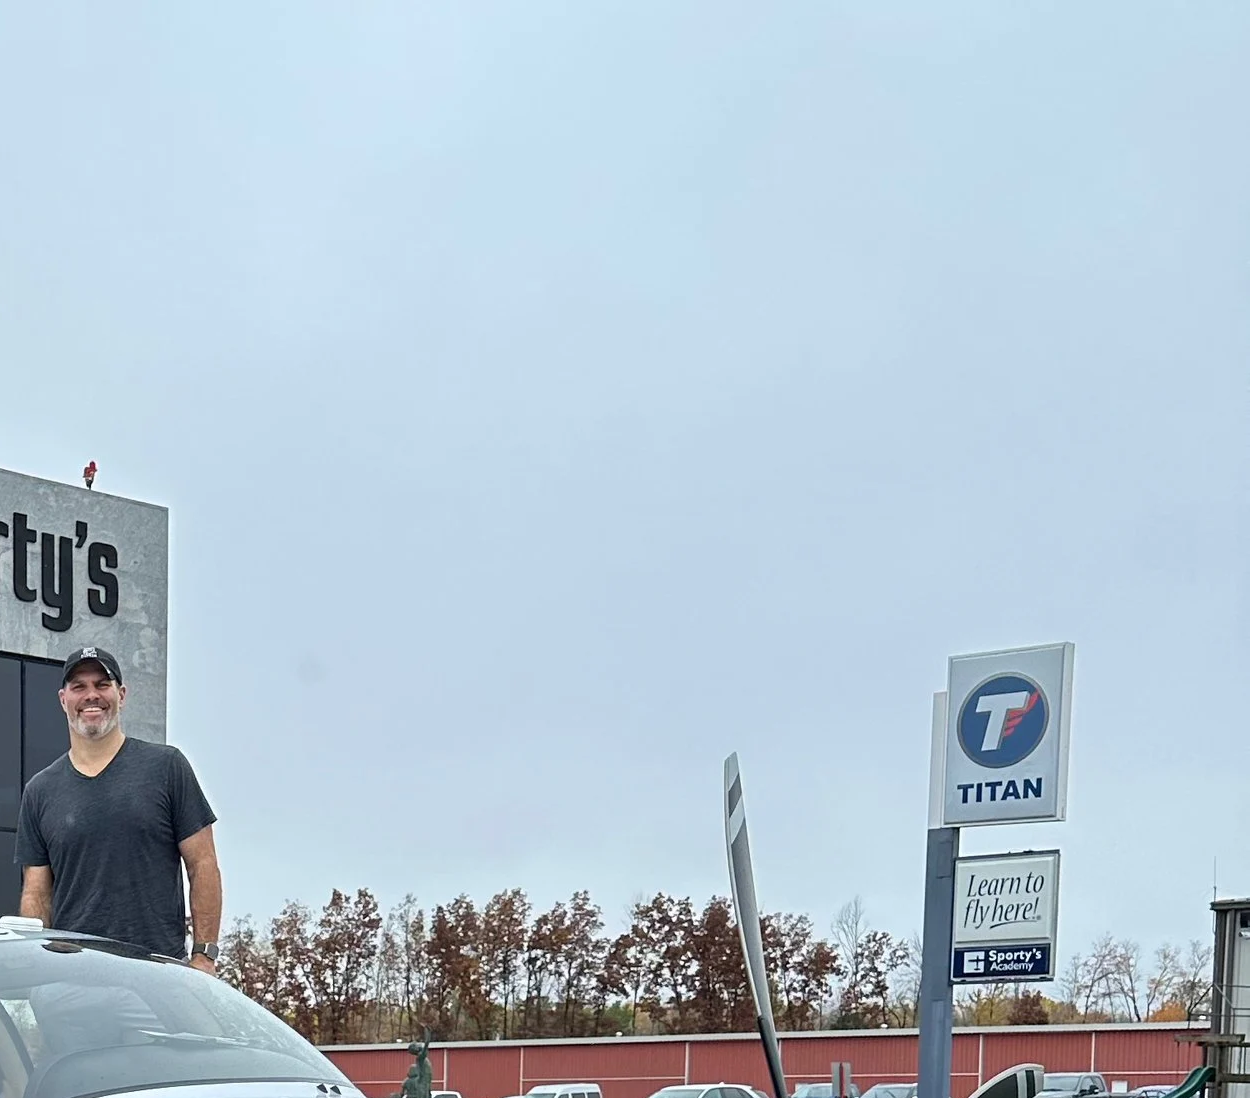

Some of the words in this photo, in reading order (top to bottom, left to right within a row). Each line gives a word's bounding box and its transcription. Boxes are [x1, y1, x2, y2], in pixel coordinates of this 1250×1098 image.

[956, 777, 1043, 804] TITAN
[966, 874, 1021, 898] Learn
[1025, 871, 1045, 894] to
[963, 898, 991, 930] fly
[991, 896, 1040, 922] here!
[988, 948, 1042, 963] Sporty's
[989, 961, 1035, 972] Academy
